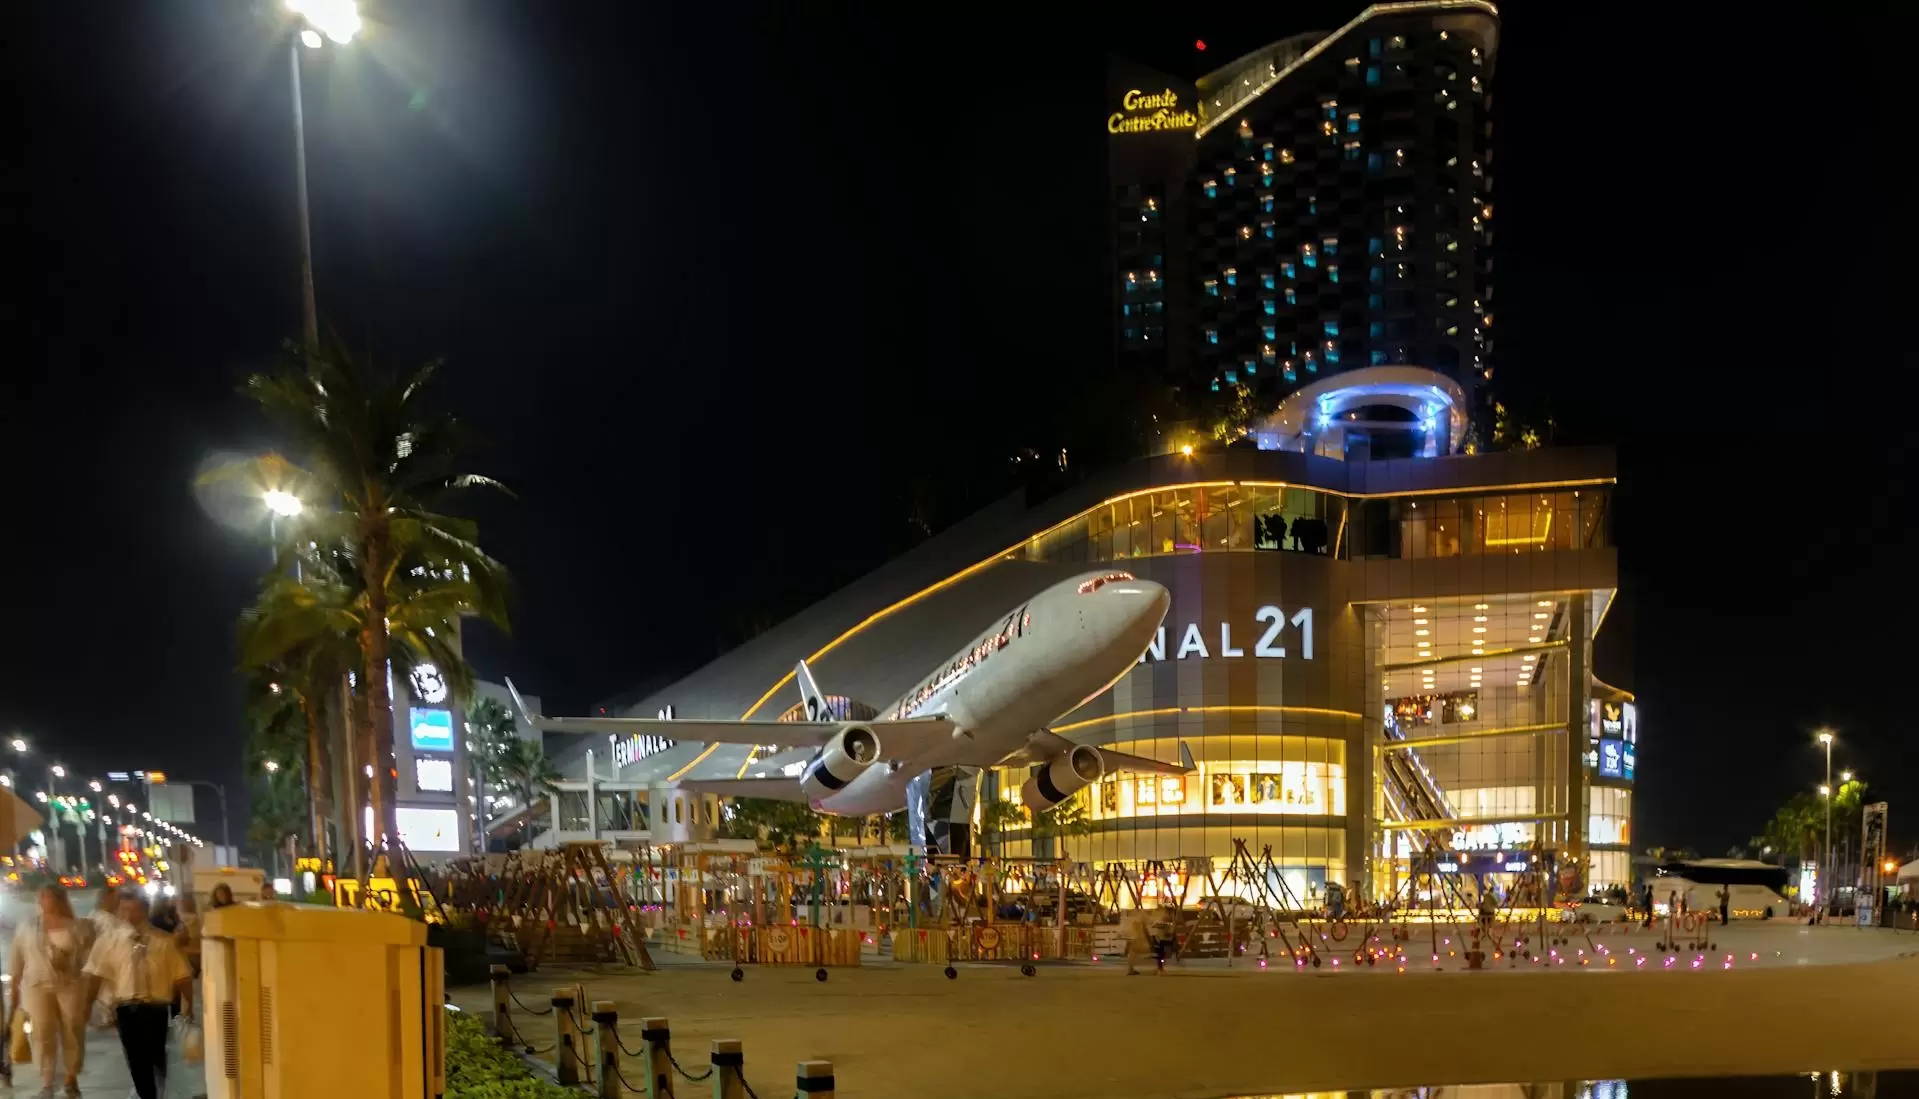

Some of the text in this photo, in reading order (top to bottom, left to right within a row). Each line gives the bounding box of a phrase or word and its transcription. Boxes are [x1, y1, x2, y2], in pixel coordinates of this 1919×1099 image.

[1123, 88, 1177, 110] Grande
[1255, 604, 1314, 660] 21
[608, 733, 660, 769] TERMINAL
